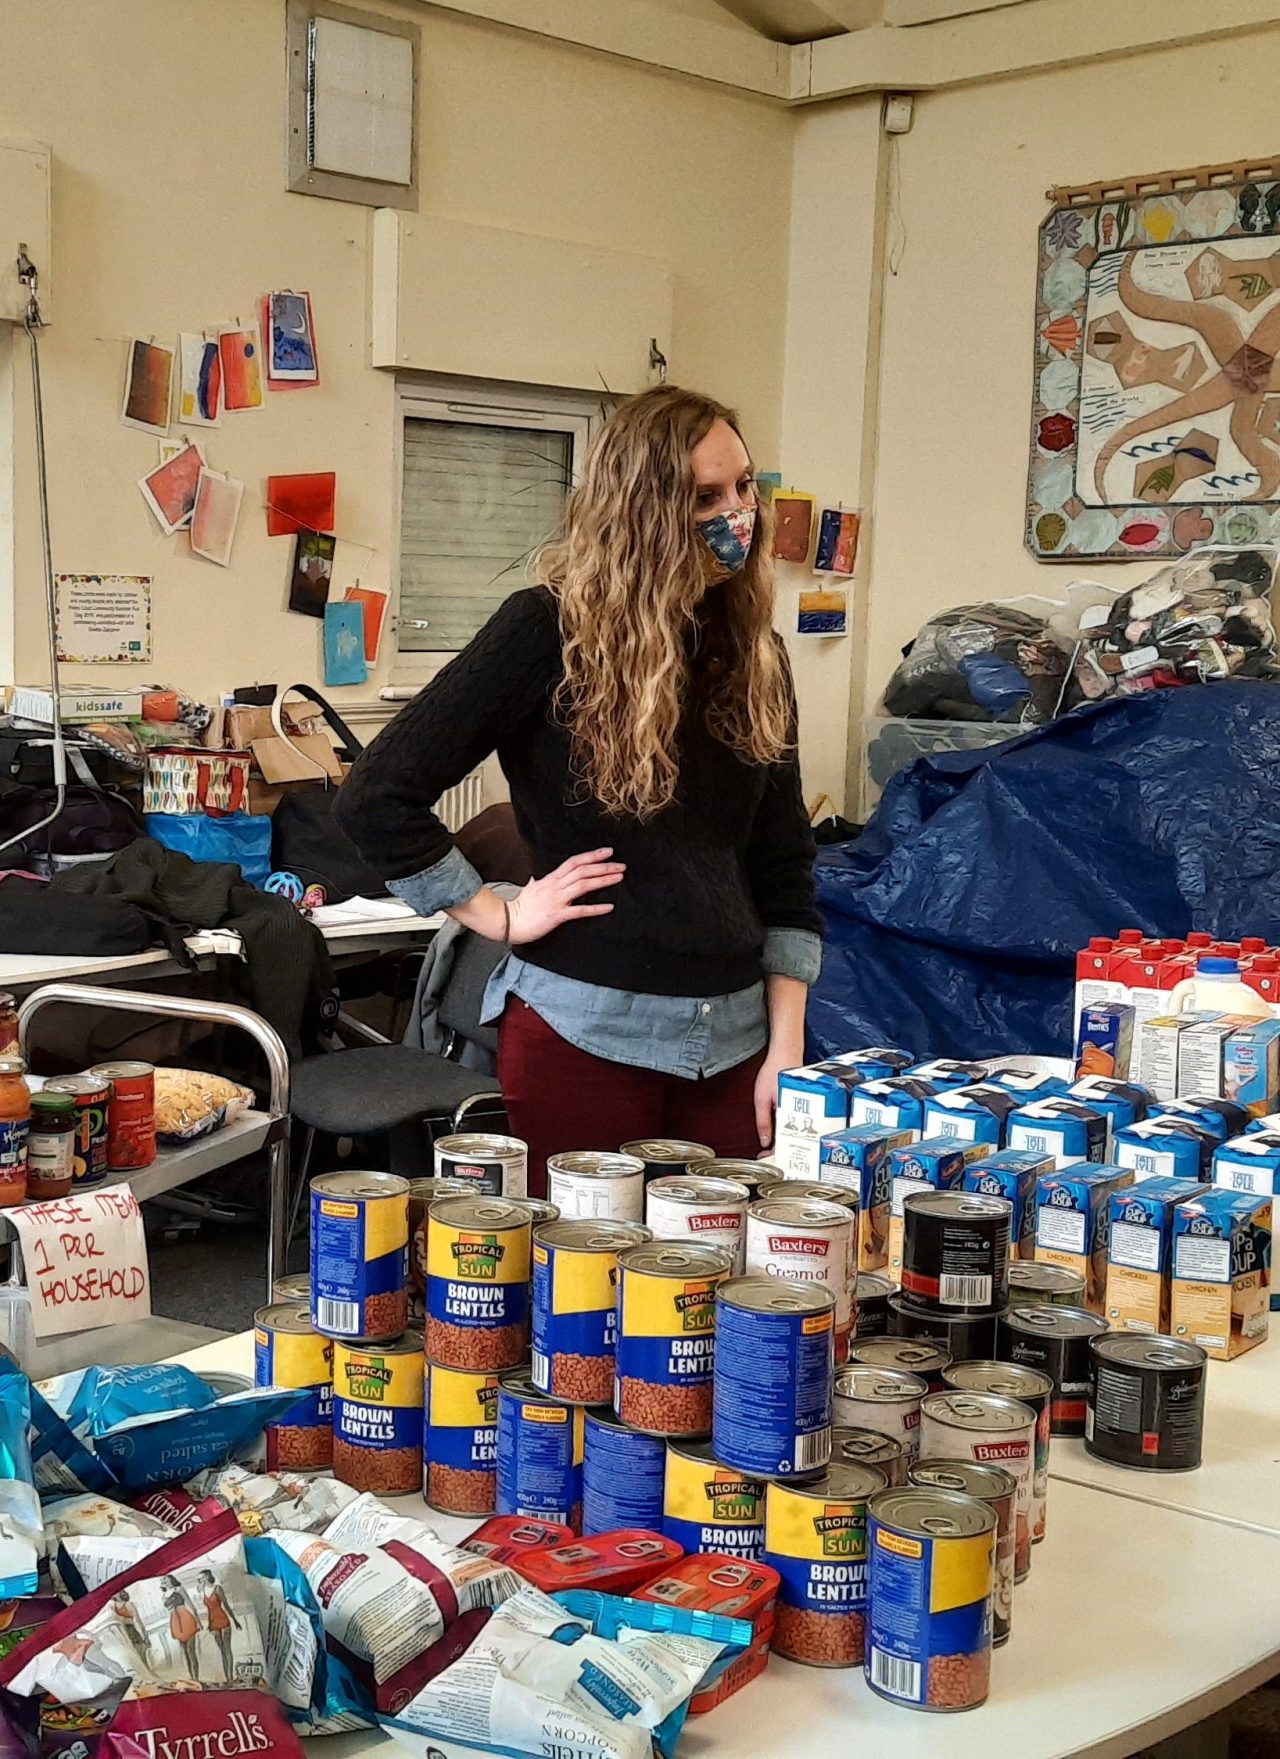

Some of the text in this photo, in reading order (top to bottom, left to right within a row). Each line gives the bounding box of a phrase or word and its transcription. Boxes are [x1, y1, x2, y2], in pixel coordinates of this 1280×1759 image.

[874, 1185, 889, 1201] SO
[12, 1198, 92, 1225] THESE
[690, 1214, 740, 1230] Baxters
[452, 1244, 503, 1258] TROPICAL
[770, 1238, 828, 1255] Baxters
[34, 1238, 56, 1276] 1
[461, 1263, 493, 1276] SUN
[765, 1263, 831, 1281] Cream of
[40, 1266, 145, 1307] HOUSEHOLD
[447, 1283, 504, 1302] BROWN
[677, 1293, 716, 1308] TROPIC
[445, 1301, 506, 1318] LENTILS
[346, 1364, 391, 1382] TROPICAL
[668, 1357, 716, 1374] LENTI
[352, 1383, 382, 1399] SUN
[342, 1401, 393, 1424] BROWN
[340, 1416, 396, 1440] LENTILS
[977, 1442, 1030, 1460] Baxters
[706, 1482, 763, 1497] TROPICAL
[716, 1504, 753, 1518] SUN
[816, 1517, 867, 1531] TROPICA
[826, 1539, 863, 1553] SUN
[806, 1582, 867, 1602] LENTIL
